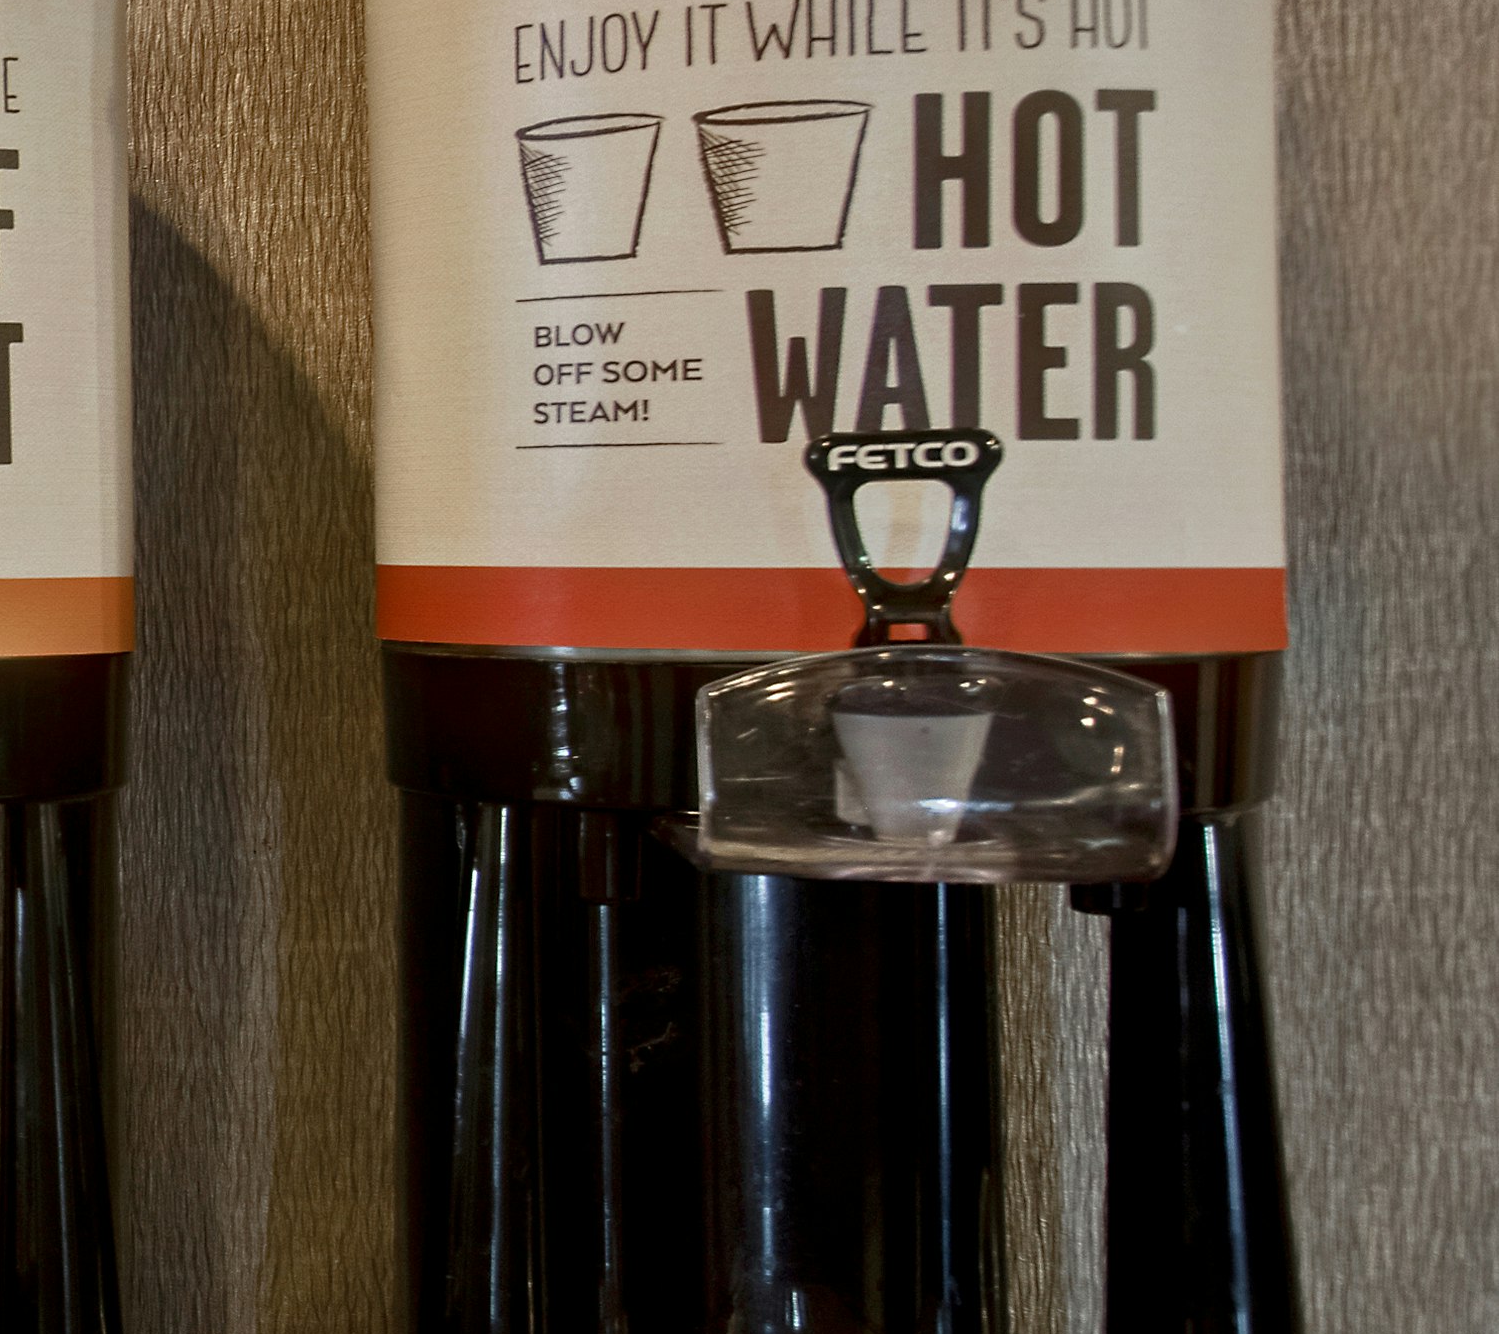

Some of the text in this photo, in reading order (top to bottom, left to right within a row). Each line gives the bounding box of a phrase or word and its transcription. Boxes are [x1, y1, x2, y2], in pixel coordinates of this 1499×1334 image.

[514, 10, 660, 85] ENJOY
[684, 2, 728, 67] IT
[913, 88, 1157, 251] HOT
[534, 322, 626, 348] BLOW
[533, 358, 704, 386] OFF SOME
[745, 281, 1156, 443] WATER
[533, 399, 650, 425] STEAM!
[827, 440, 981, 471] FETCO
